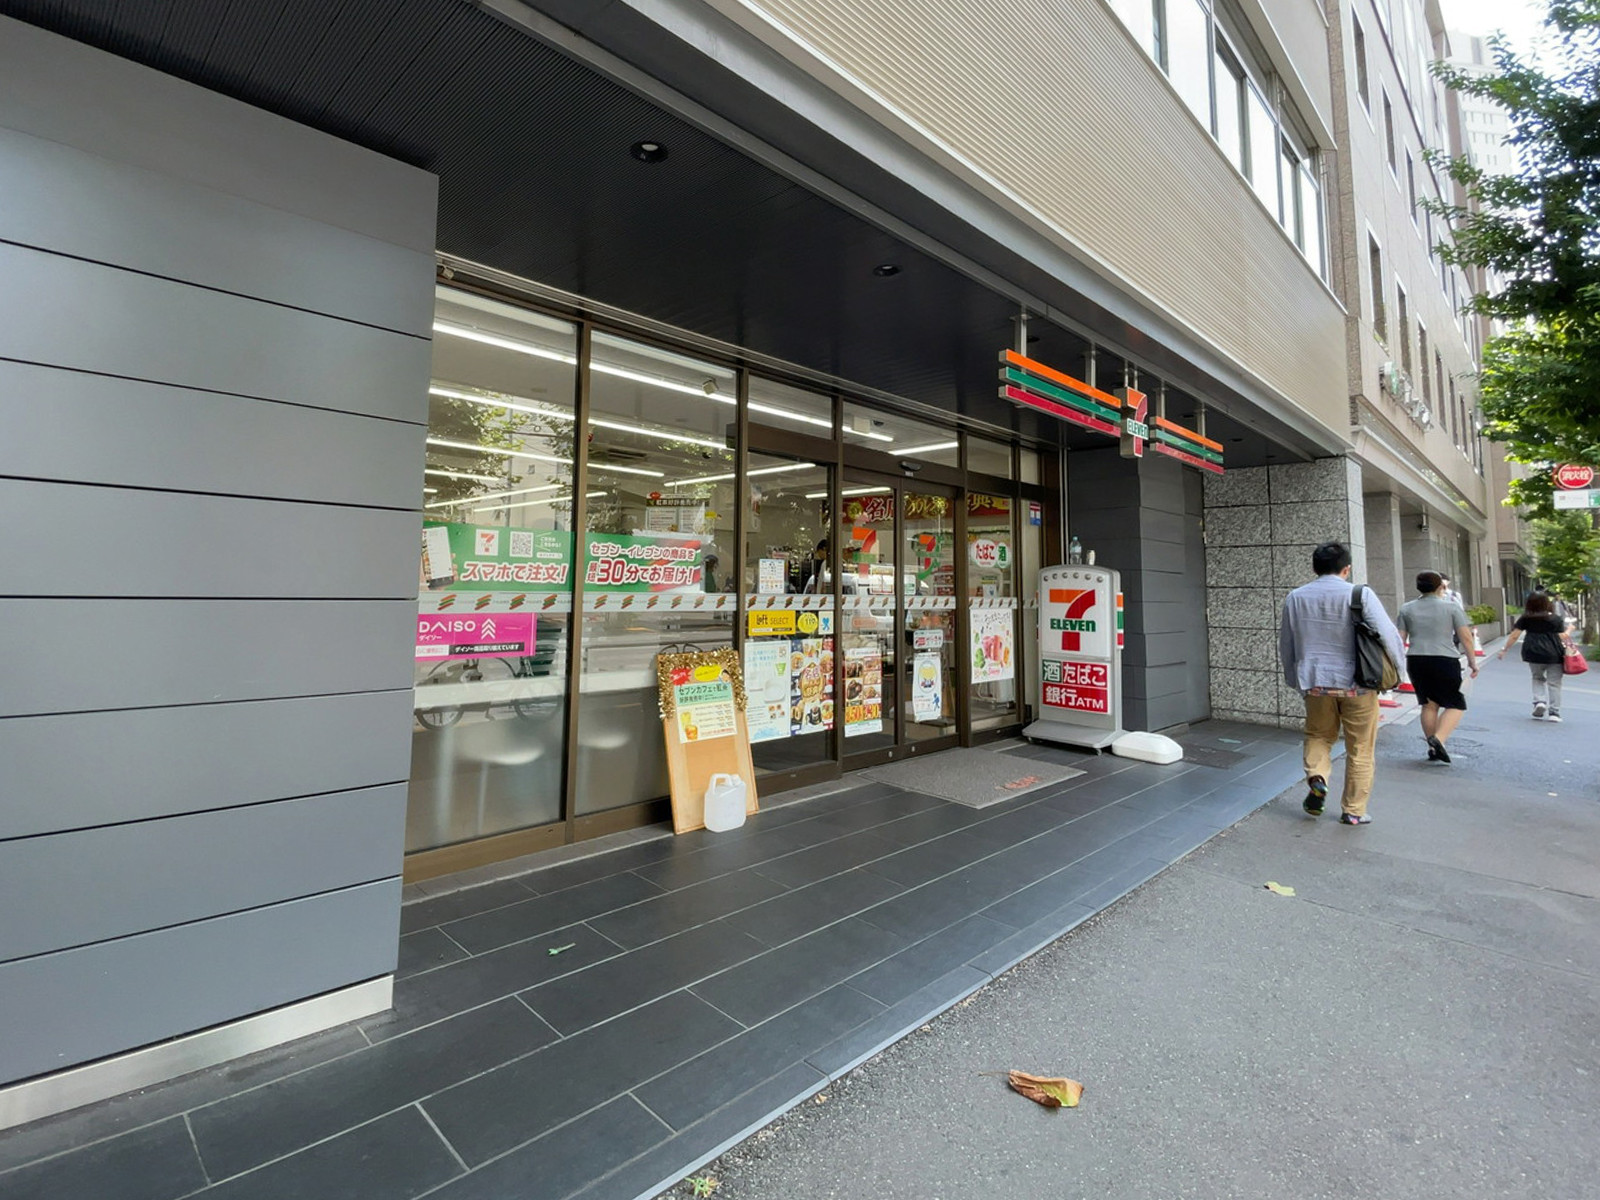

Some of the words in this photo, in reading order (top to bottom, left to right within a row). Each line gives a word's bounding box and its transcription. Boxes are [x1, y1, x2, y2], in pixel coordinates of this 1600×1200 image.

[1127, 387, 1148, 457] 7
[1562, 470, 1591, 481] 消火栓
[975, 543, 996, 560] たばこ
[998, 545, 1008, 562] 酒
[462, 562, 569, 583] スマホで注文!
[418, 621, 477, 633] DAISO
[1049, 589, 1096, 651] 7
[1043, 661, 1061, 682] 酒
[1062, 664, 1106, 687] たばこ
[1045, 686, 1104, 709] 銀行ATM
